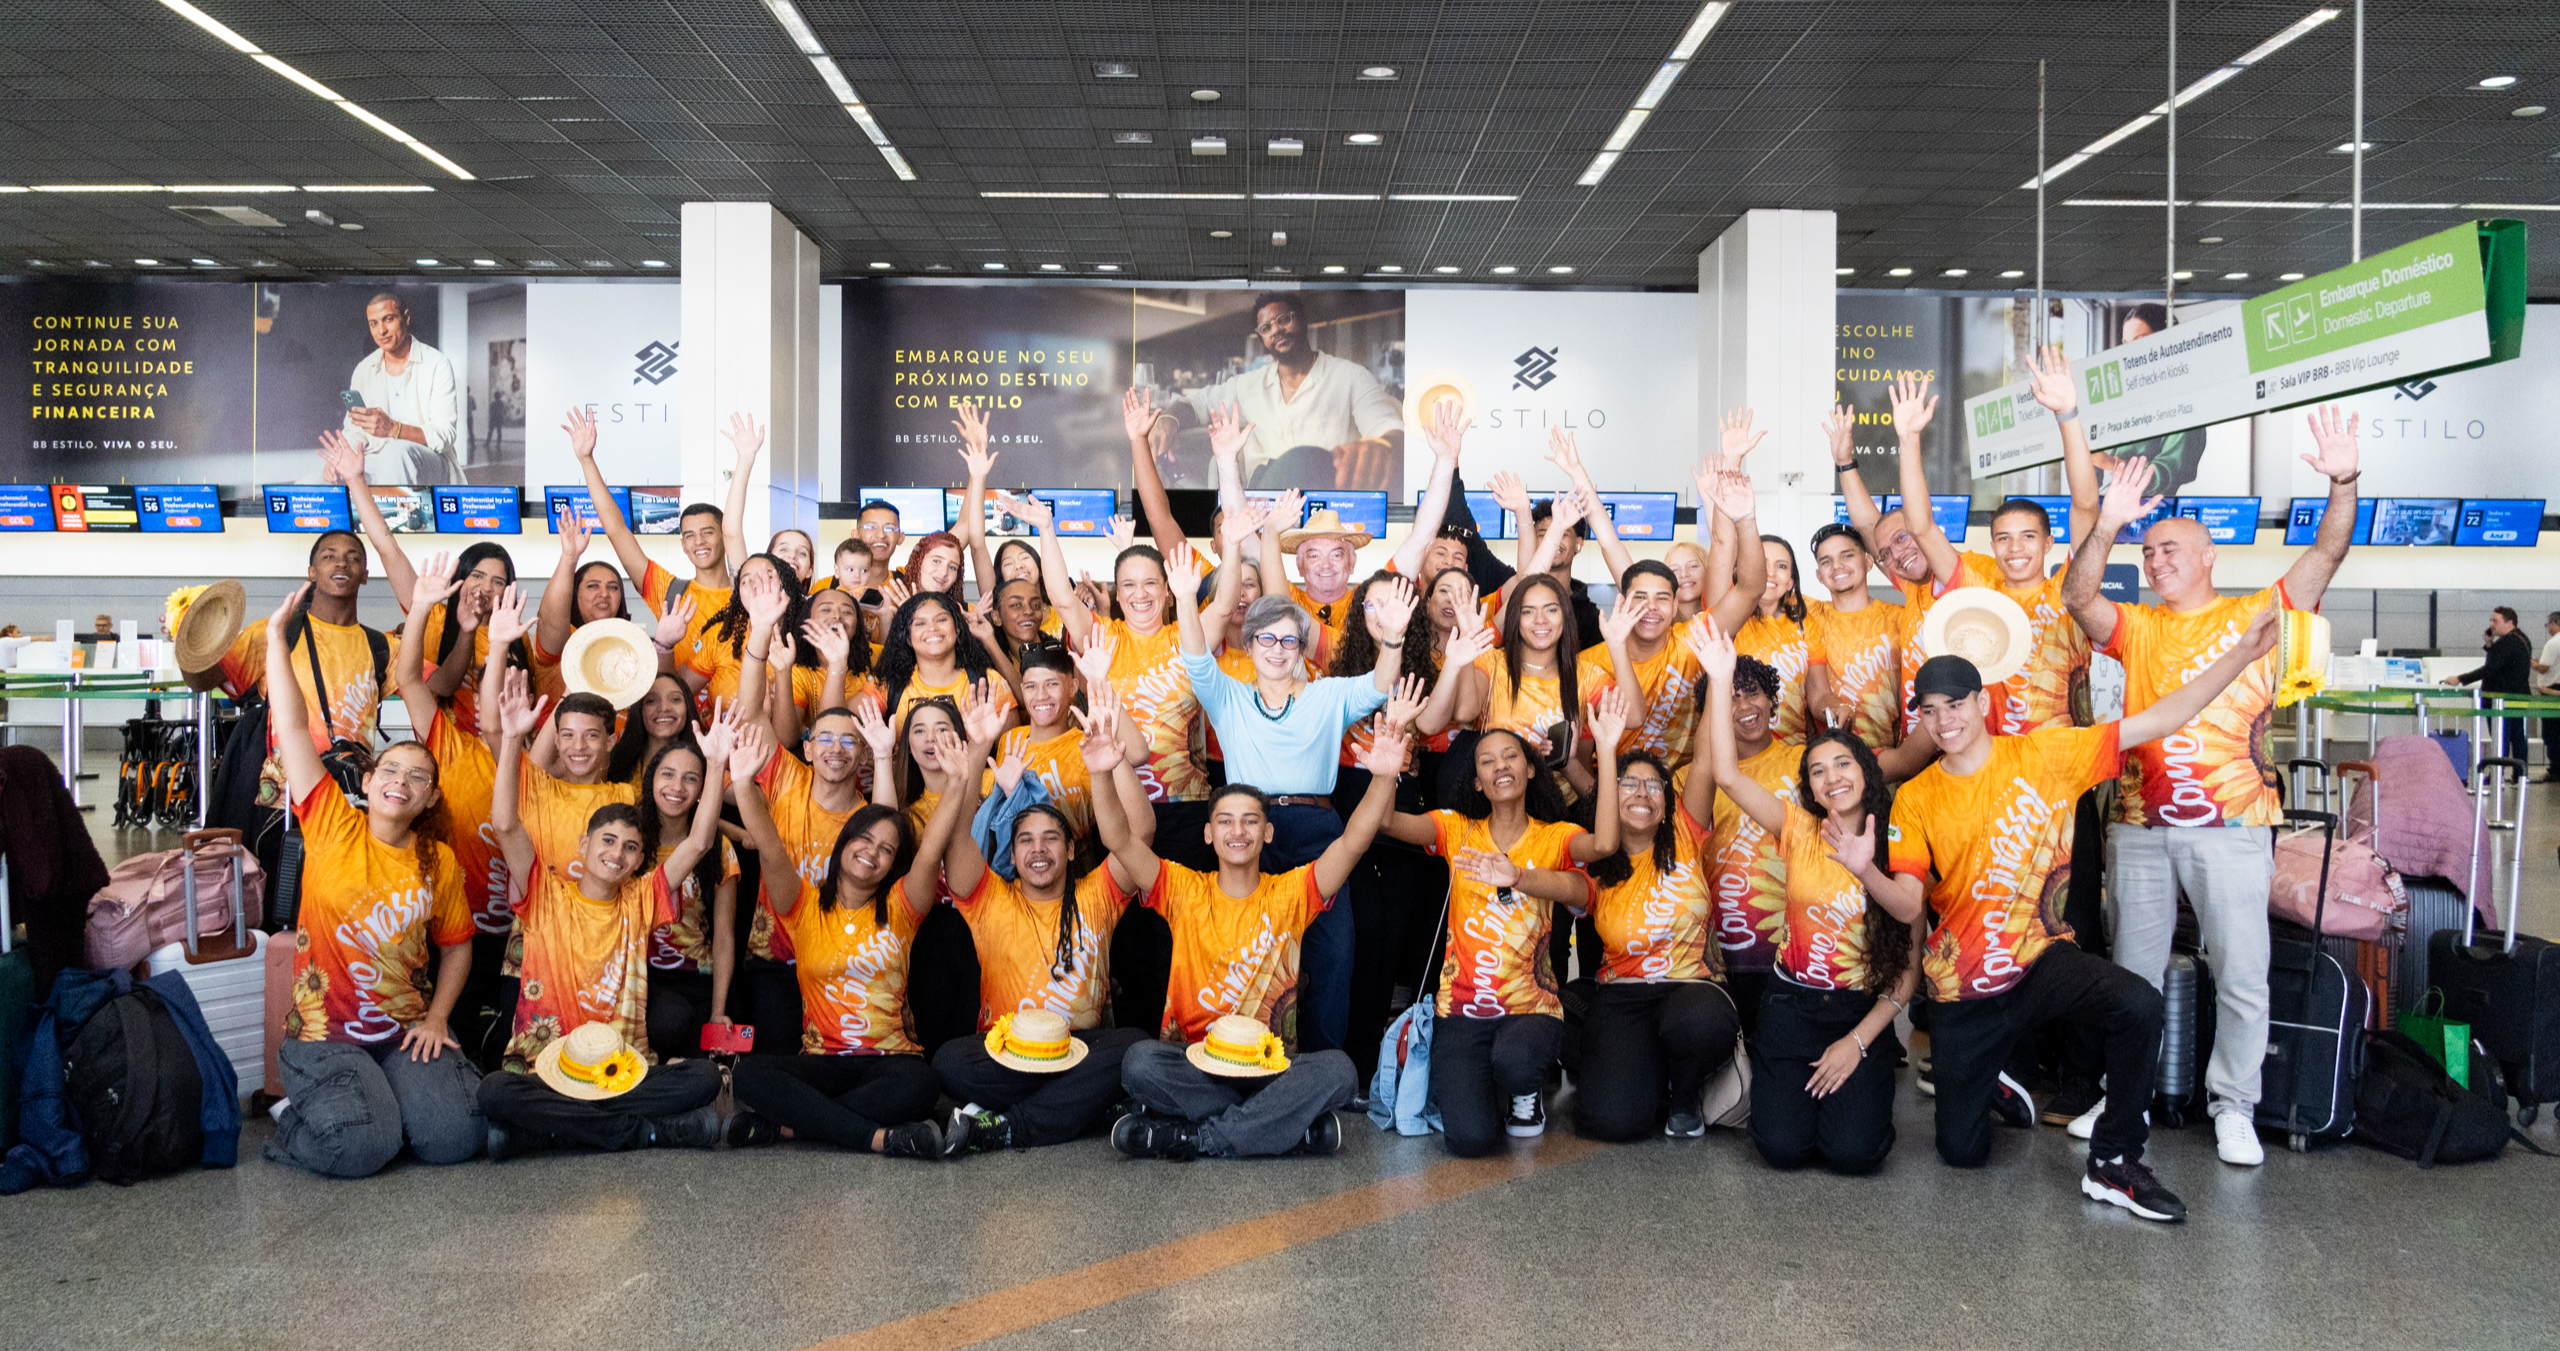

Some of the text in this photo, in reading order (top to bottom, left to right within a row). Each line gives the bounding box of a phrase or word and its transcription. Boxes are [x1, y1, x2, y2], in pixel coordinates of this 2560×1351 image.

[2319, 252, 2454, 308] Embarque Doméstico
[2323, 291, 2431, 335] Domestic Departure
[33, 316, 179, 329] CONTINUE SUA
[33, 339, 176, 351] JORNADA COM
[2122, 326, 2233, 370] Totens de Autoatendimento
[896, 350, 1093, 364] EMBARQUE NO SEU
[33, 361, 194, 375] TRANQUILIDADE
[2280, 350, 2400, 389] Sala VIP BRB BRB Vip Lounge
[896, 370, 1089, 386] PRÓXIMO DESTINO
[2125, 362, 2189, 391] Self check-in kiosks
[32, 383, 168, 399] E SEGURANÇA
[895, 395, 1022, 409] COM ESTILO
[32, 406, 155, 419] FINANCEIRA
[585, 403, 668, 423] ESTI
[2018, 406, 2045, 421] Ticket Sale
[2107, 403, 2193, 433] Praça de Serviço Service Plaza
[32, 440, 178, 449] BB ESTILO. VIVA O SEU.
[896, 435, 961, 443] BB ESTILO.
[1002, 435, 1009, 443] O
[1016, 435, 1043, 443] SEU.
[144, 502, 158, 512] 56
[273, 502, 286, 512] 57
[443, 503, 456, 512] 58
[1311, 507, 1323, 516] 6
[9, 517, 25, 525] GOL
[304, 518, 321, 526] GOL
[1068, 522, 1085, 530] GOL
[2297, 515, 2309, 524] 71
[2467, 517, 2479, 525] 72
[1627, 525, 1643, 533] GOL
[1831, 634, 1893, 704] irassol
[2158, 728, 2217, 827] Como
[1971, 776, 2067, 993] Como Girassol...
[1717, 868, 1756, 951] Como
[1796, 884, 1866, 990] Como Giras
[1462, 946, 1505, 1019] Como
